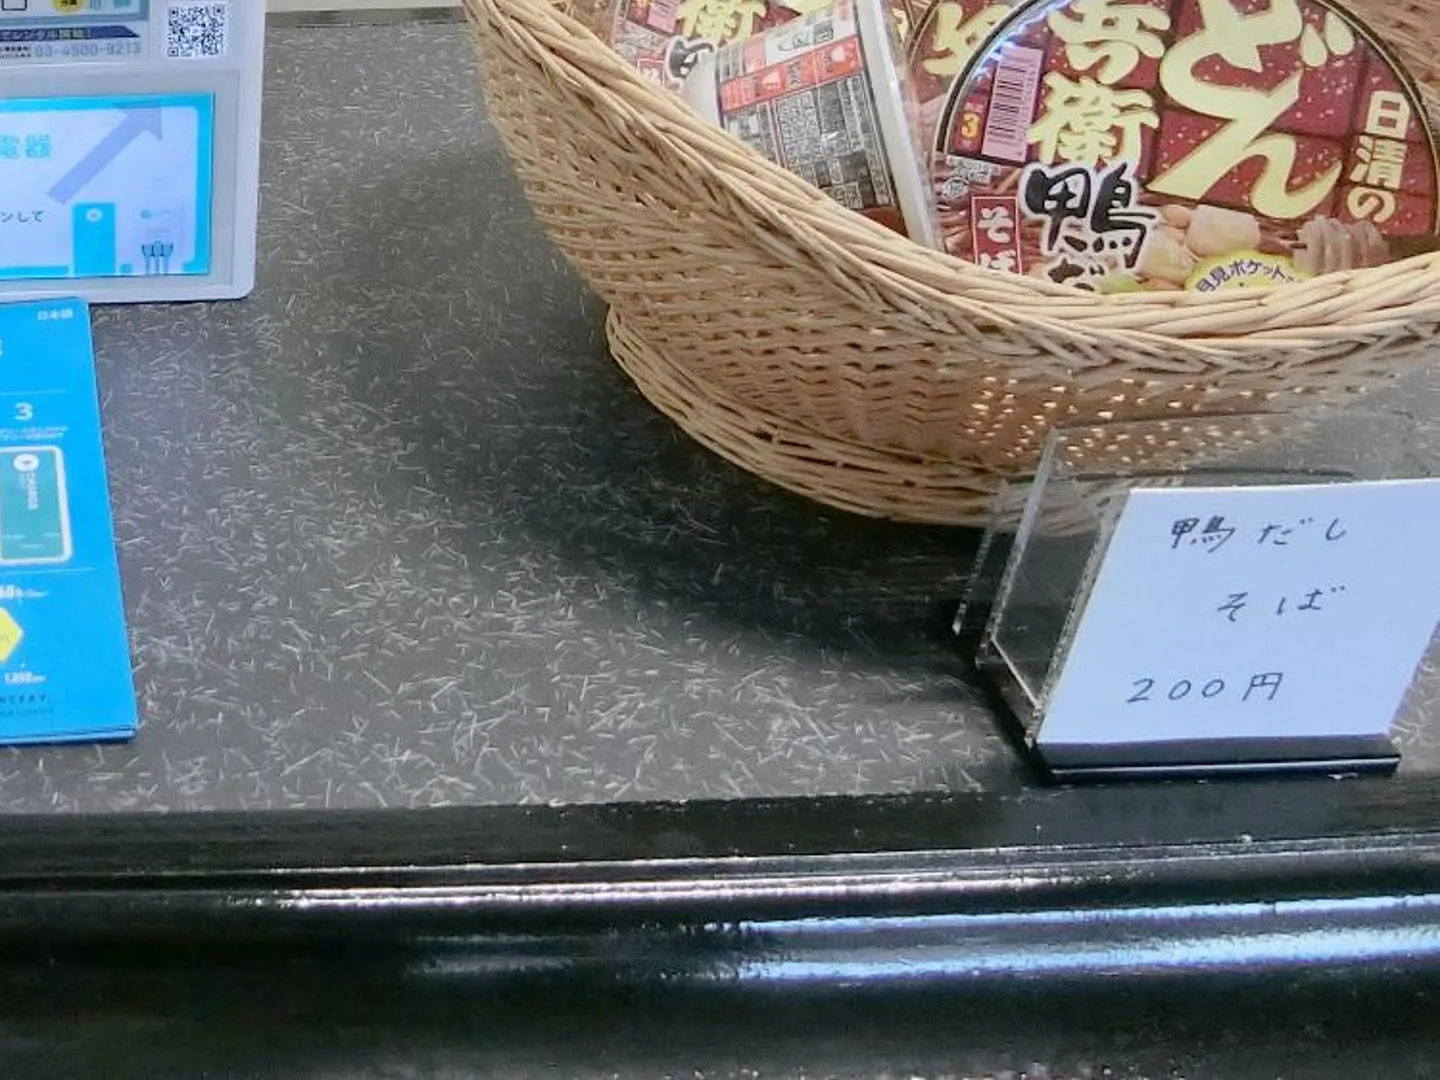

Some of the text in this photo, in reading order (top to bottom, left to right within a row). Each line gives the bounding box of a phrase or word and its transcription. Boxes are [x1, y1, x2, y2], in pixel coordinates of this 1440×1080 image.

[1346, 91, 1410, 224] 日清の
[14, 402, 35, 421] 3
[1170, 514, 1348, 554] 鴨だし
[1216, 585, 1347, 622] そば
[1126, 671, 1284, 704] 200円
